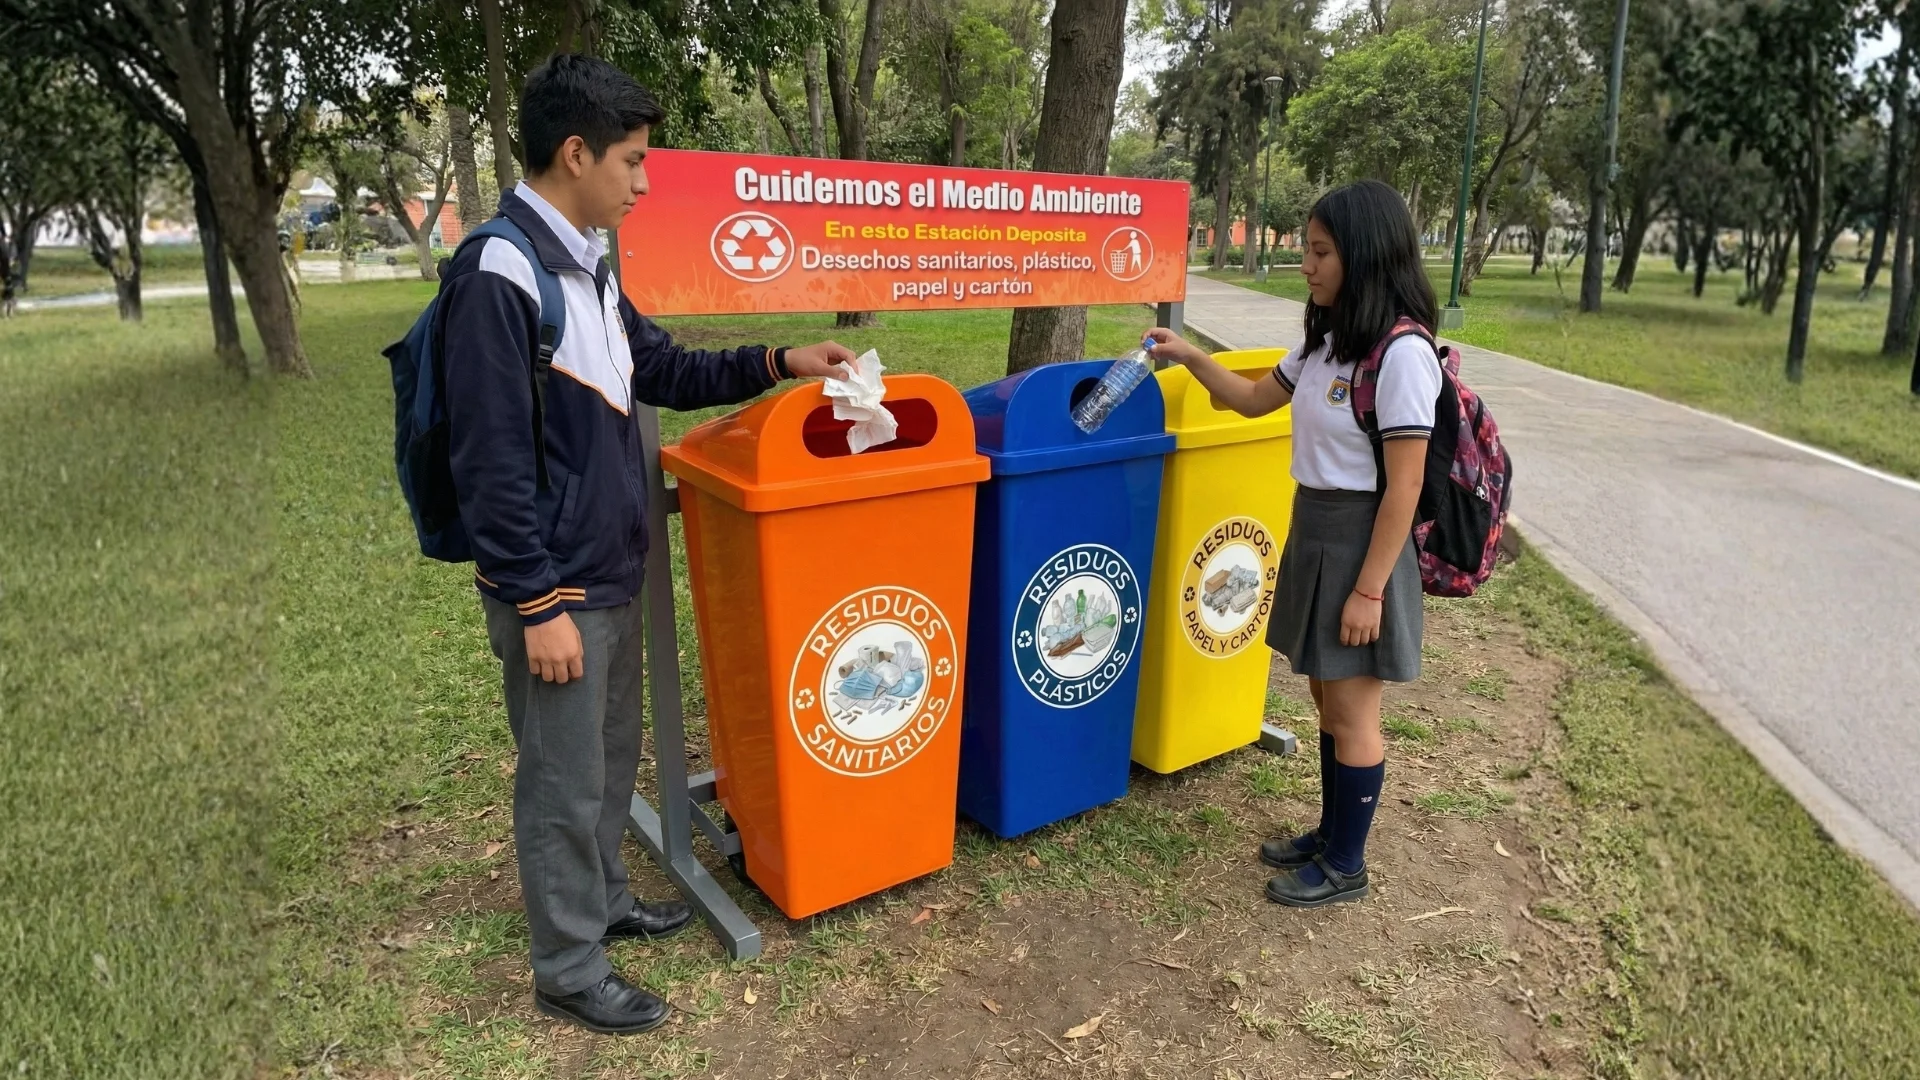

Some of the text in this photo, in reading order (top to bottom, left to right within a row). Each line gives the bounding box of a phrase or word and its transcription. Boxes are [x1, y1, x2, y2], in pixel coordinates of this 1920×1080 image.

[735, 167, 1142, 216] Cuidemos el Medio Ambiente
[825, 221, 1086, 245] En esto Estación Deposita
[801, 246, 1096, 274] Desechos sanitarios, plástico,
[893, 276, 1032, 301] papel y cartón
[1193, 522, 1271, 570] RESIDUOS
[1029, 551, 1130, 605] RESIDUOS
[809, 594, 942, 658] RESIDUOS
[1185, 610, 1215, 653] PAPEL
[1220, 639, 1228, 653] Y
[1029, 649, 1126, 702] PLÁSTICOS
[807, 696, 945, 769] SANITARIOS
